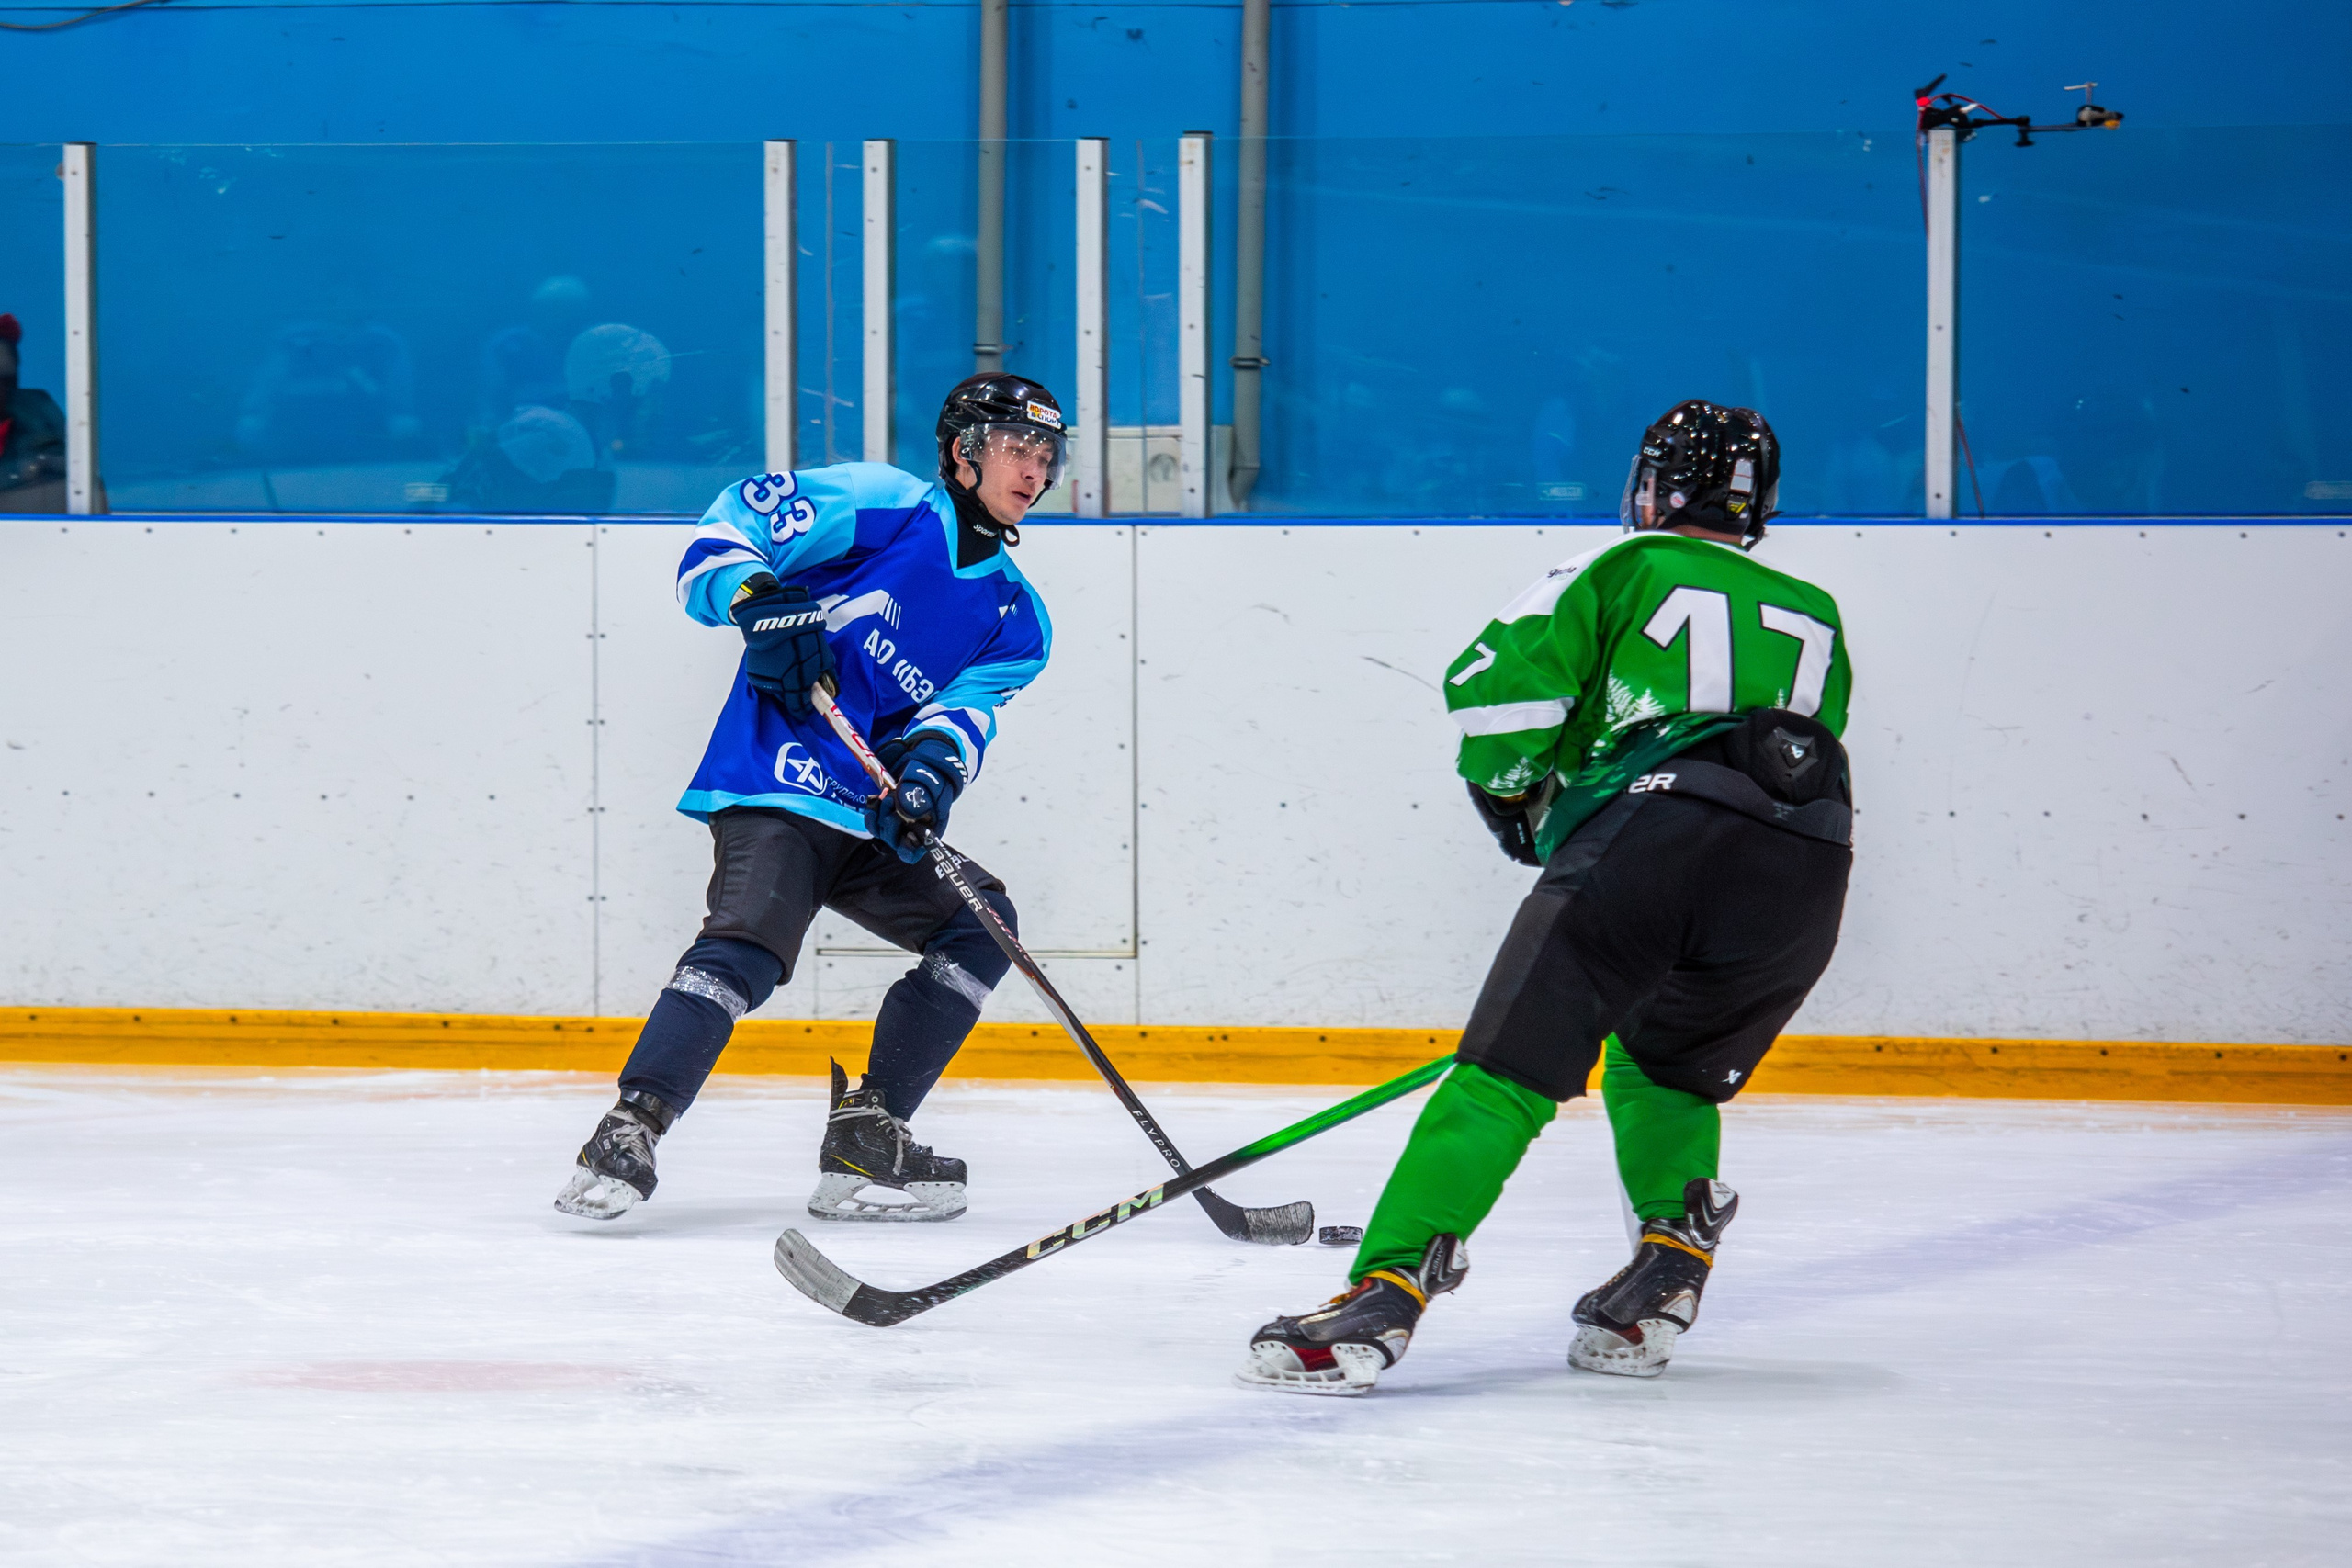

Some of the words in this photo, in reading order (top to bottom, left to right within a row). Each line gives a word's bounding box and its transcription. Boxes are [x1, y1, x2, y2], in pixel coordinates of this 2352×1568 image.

[1643, 446, 1662, 457] CCM
[740, 470, 817, 546] 33
[863, 627, 897, 666] АО
[1448, 641, 1498, 688] 7
[1639, 583, 1838, 718] 17
[929, 847, 984, 913] BAUER
[1132, 1109, 1182, 1168] FLYPRO
[1026, 1183, 1166, 1261] CCM
